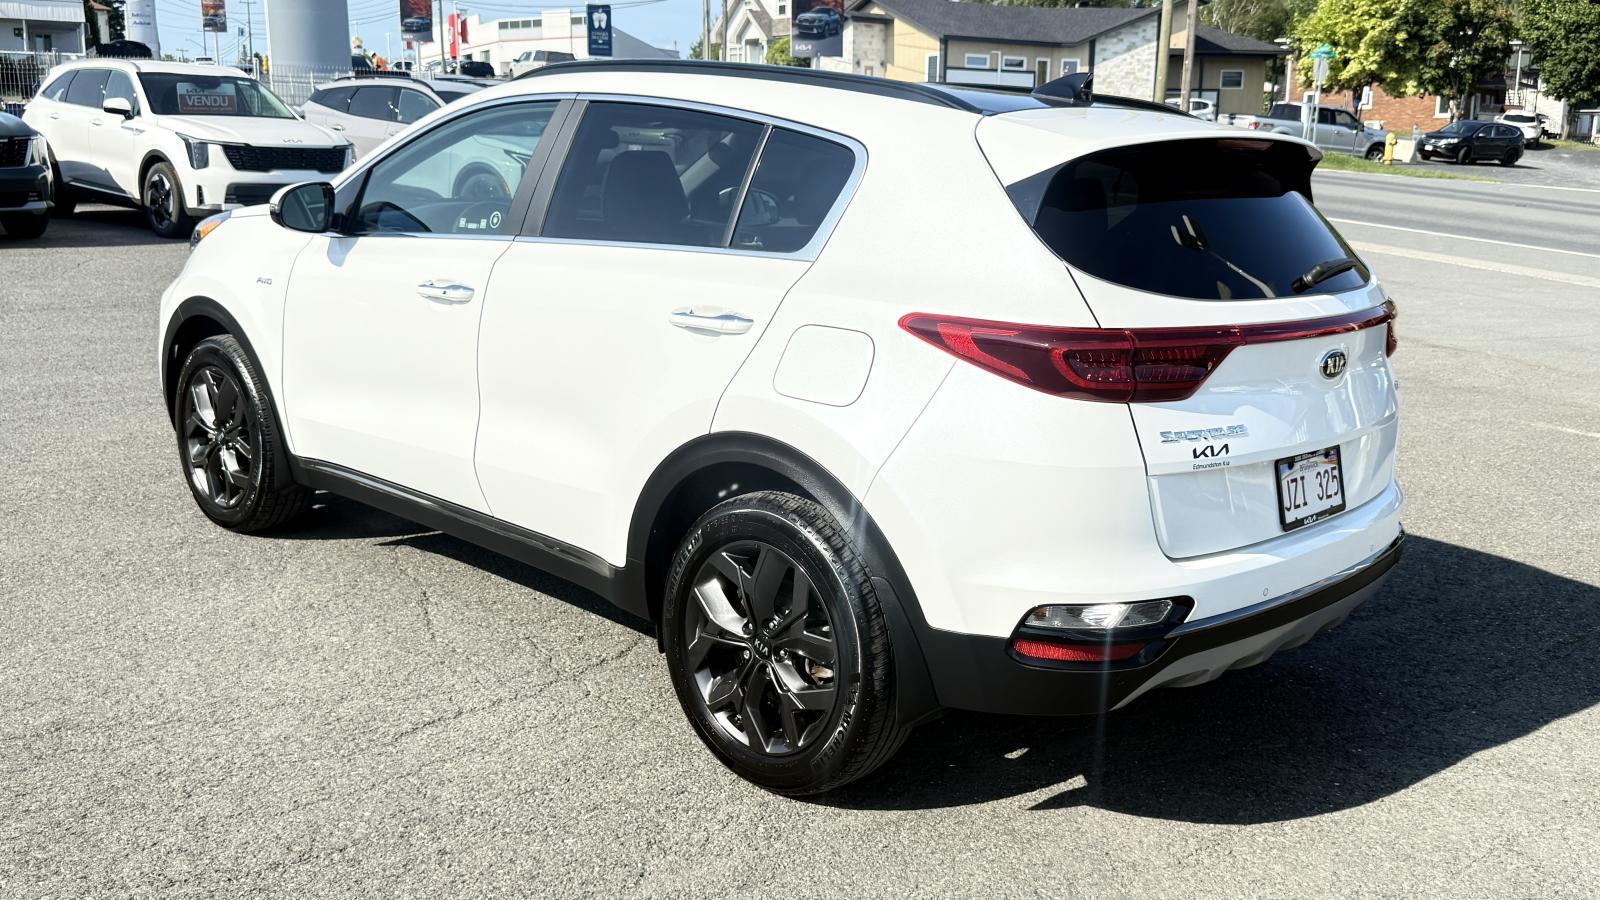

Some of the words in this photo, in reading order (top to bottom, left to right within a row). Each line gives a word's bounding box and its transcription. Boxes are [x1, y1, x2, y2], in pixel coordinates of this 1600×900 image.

[186, 95, 229, 106] VENDU
[1326, 355, 1346, 375] KIA
[1192, 443, 1230, 459] KIA
[1284, 475, 1308, 512] JZI
[1315, 466, 1340, 501] 325
[1303, 514, 1317, 525] KIA
[754, 638, 769, 656] KIA
